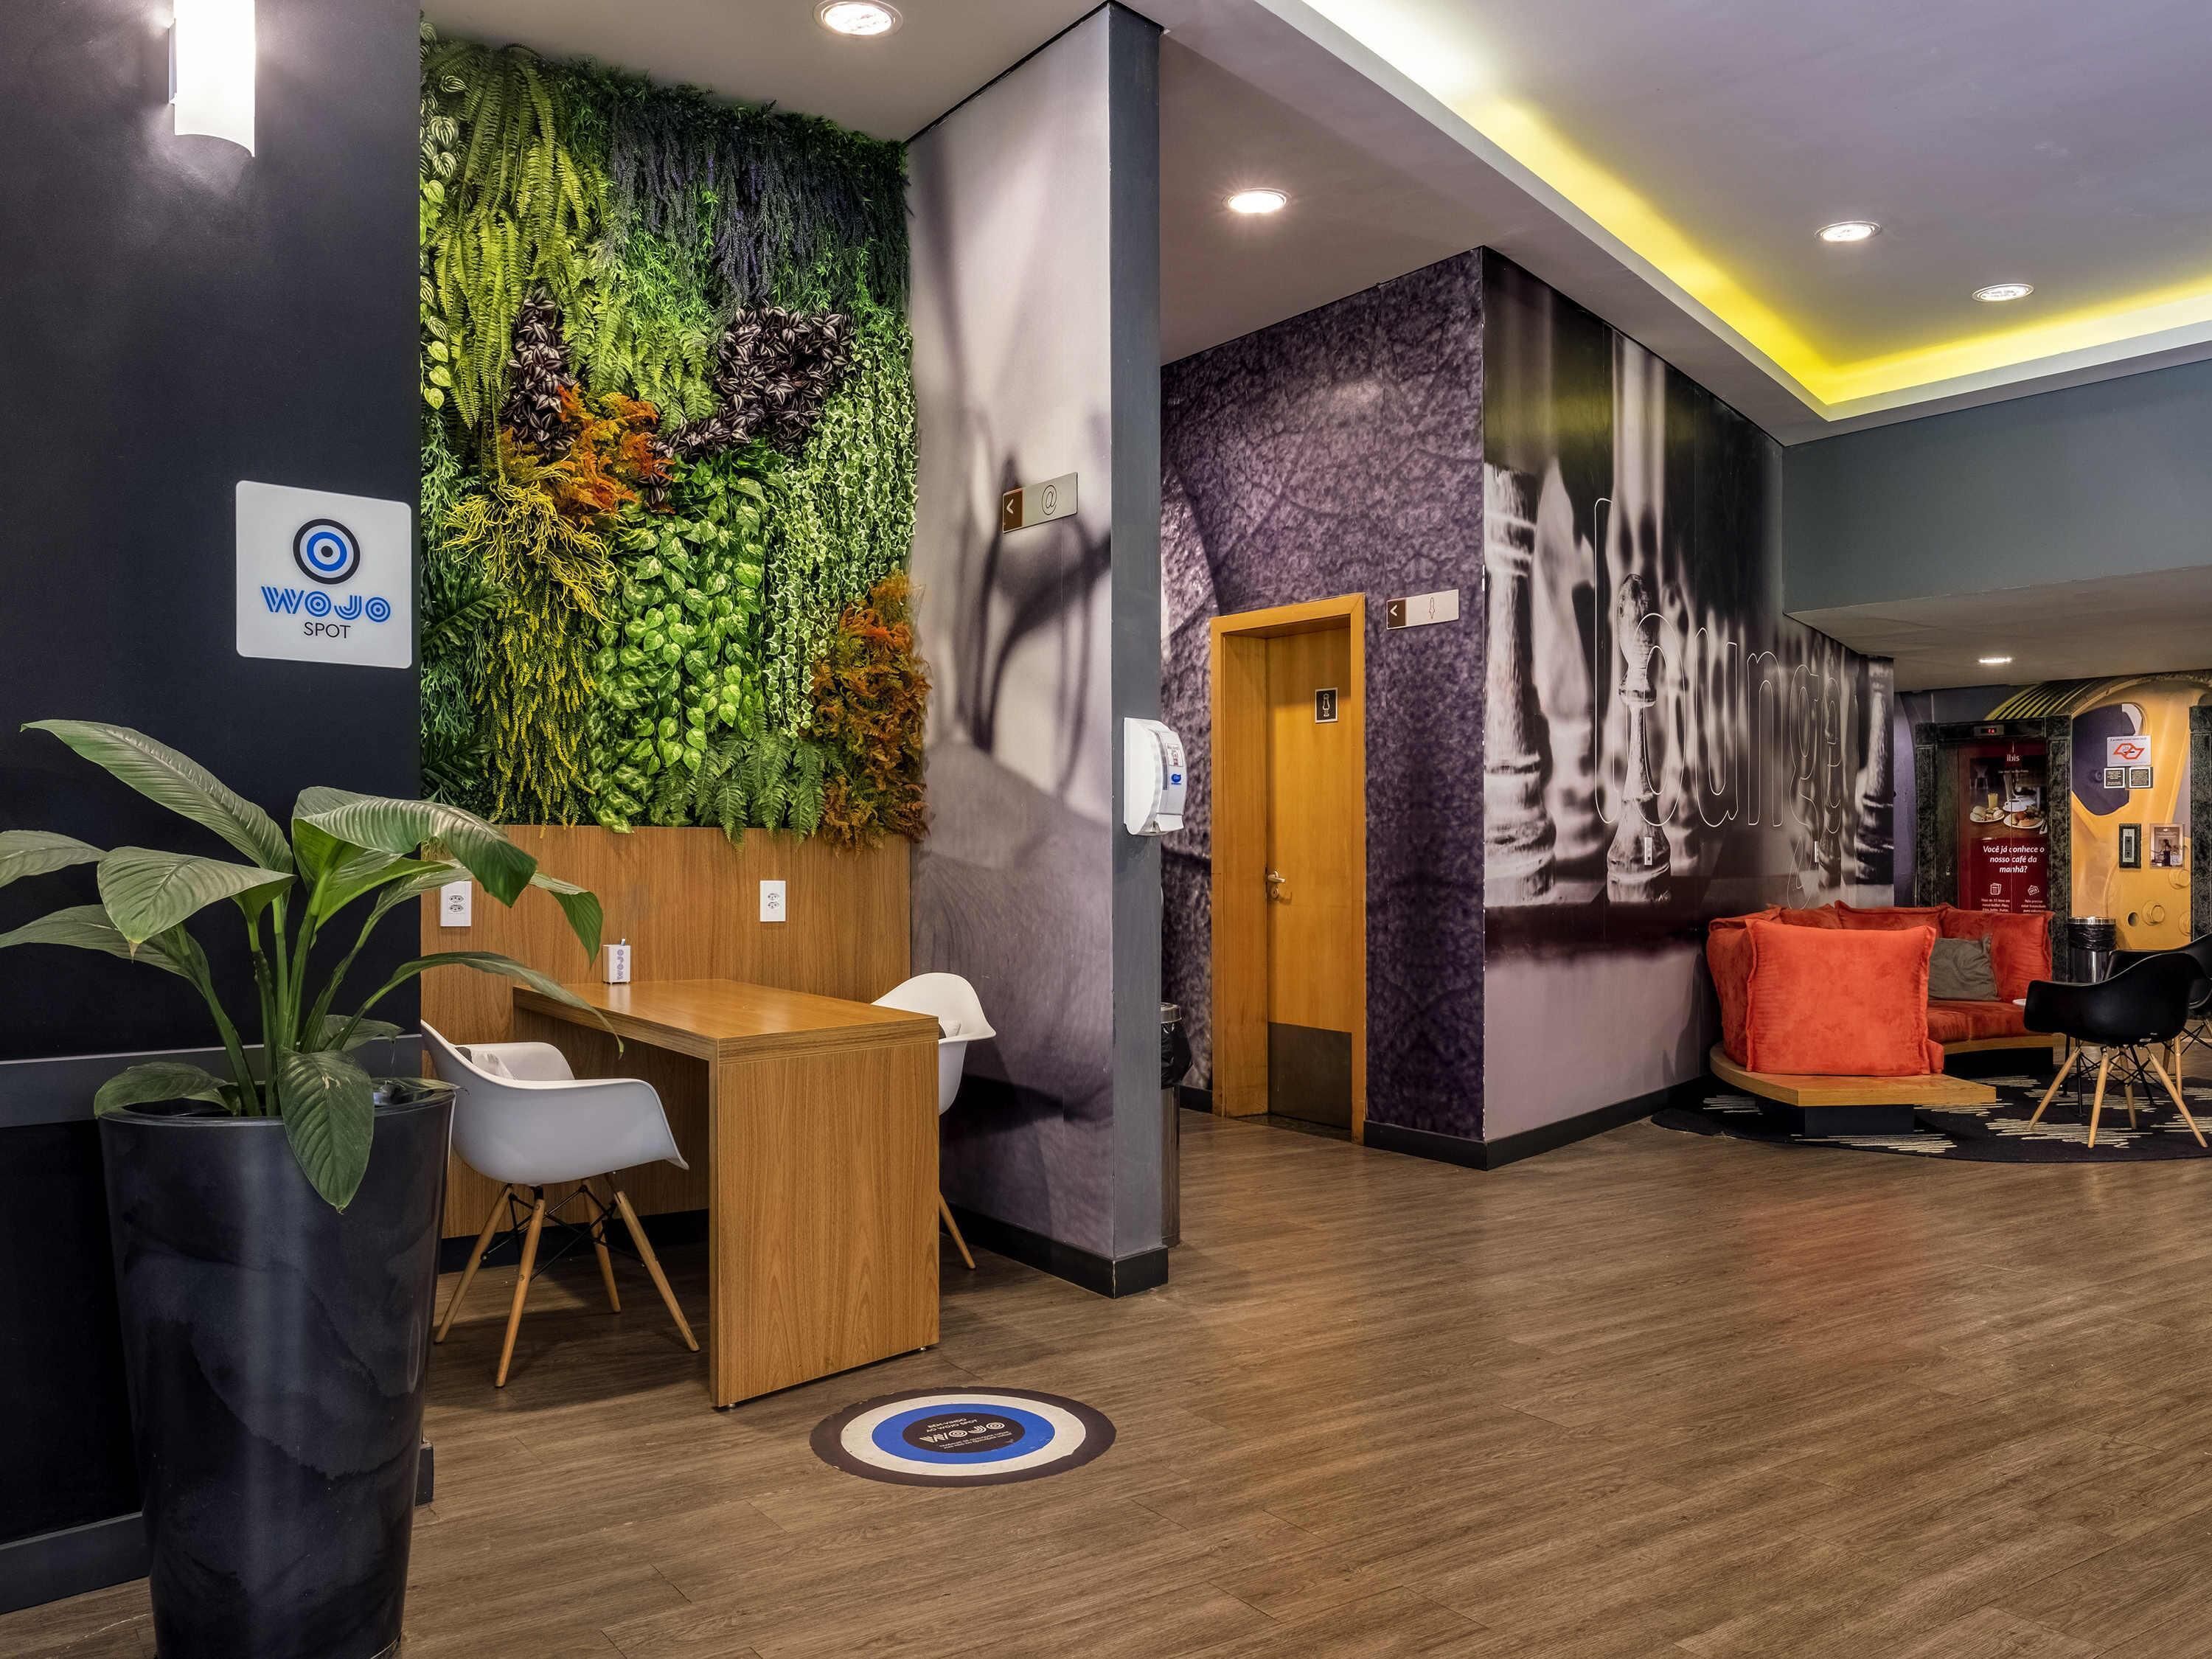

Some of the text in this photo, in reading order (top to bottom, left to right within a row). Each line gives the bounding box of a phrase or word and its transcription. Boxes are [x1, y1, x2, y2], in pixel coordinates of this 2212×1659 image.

[260, 585, 391, 623] WOJO
[303, 622, 351, 639] SPOT
[1983, 845, 2000, 853] Você
[2000, 845, 2008, 855] já
[2008, 845, 2039, 853] conhece
[2011, 855, 2027, 864] café
[1999, 865, 2028, 873] manhã?
[919, 1422, 1005, 1444] WOJO
